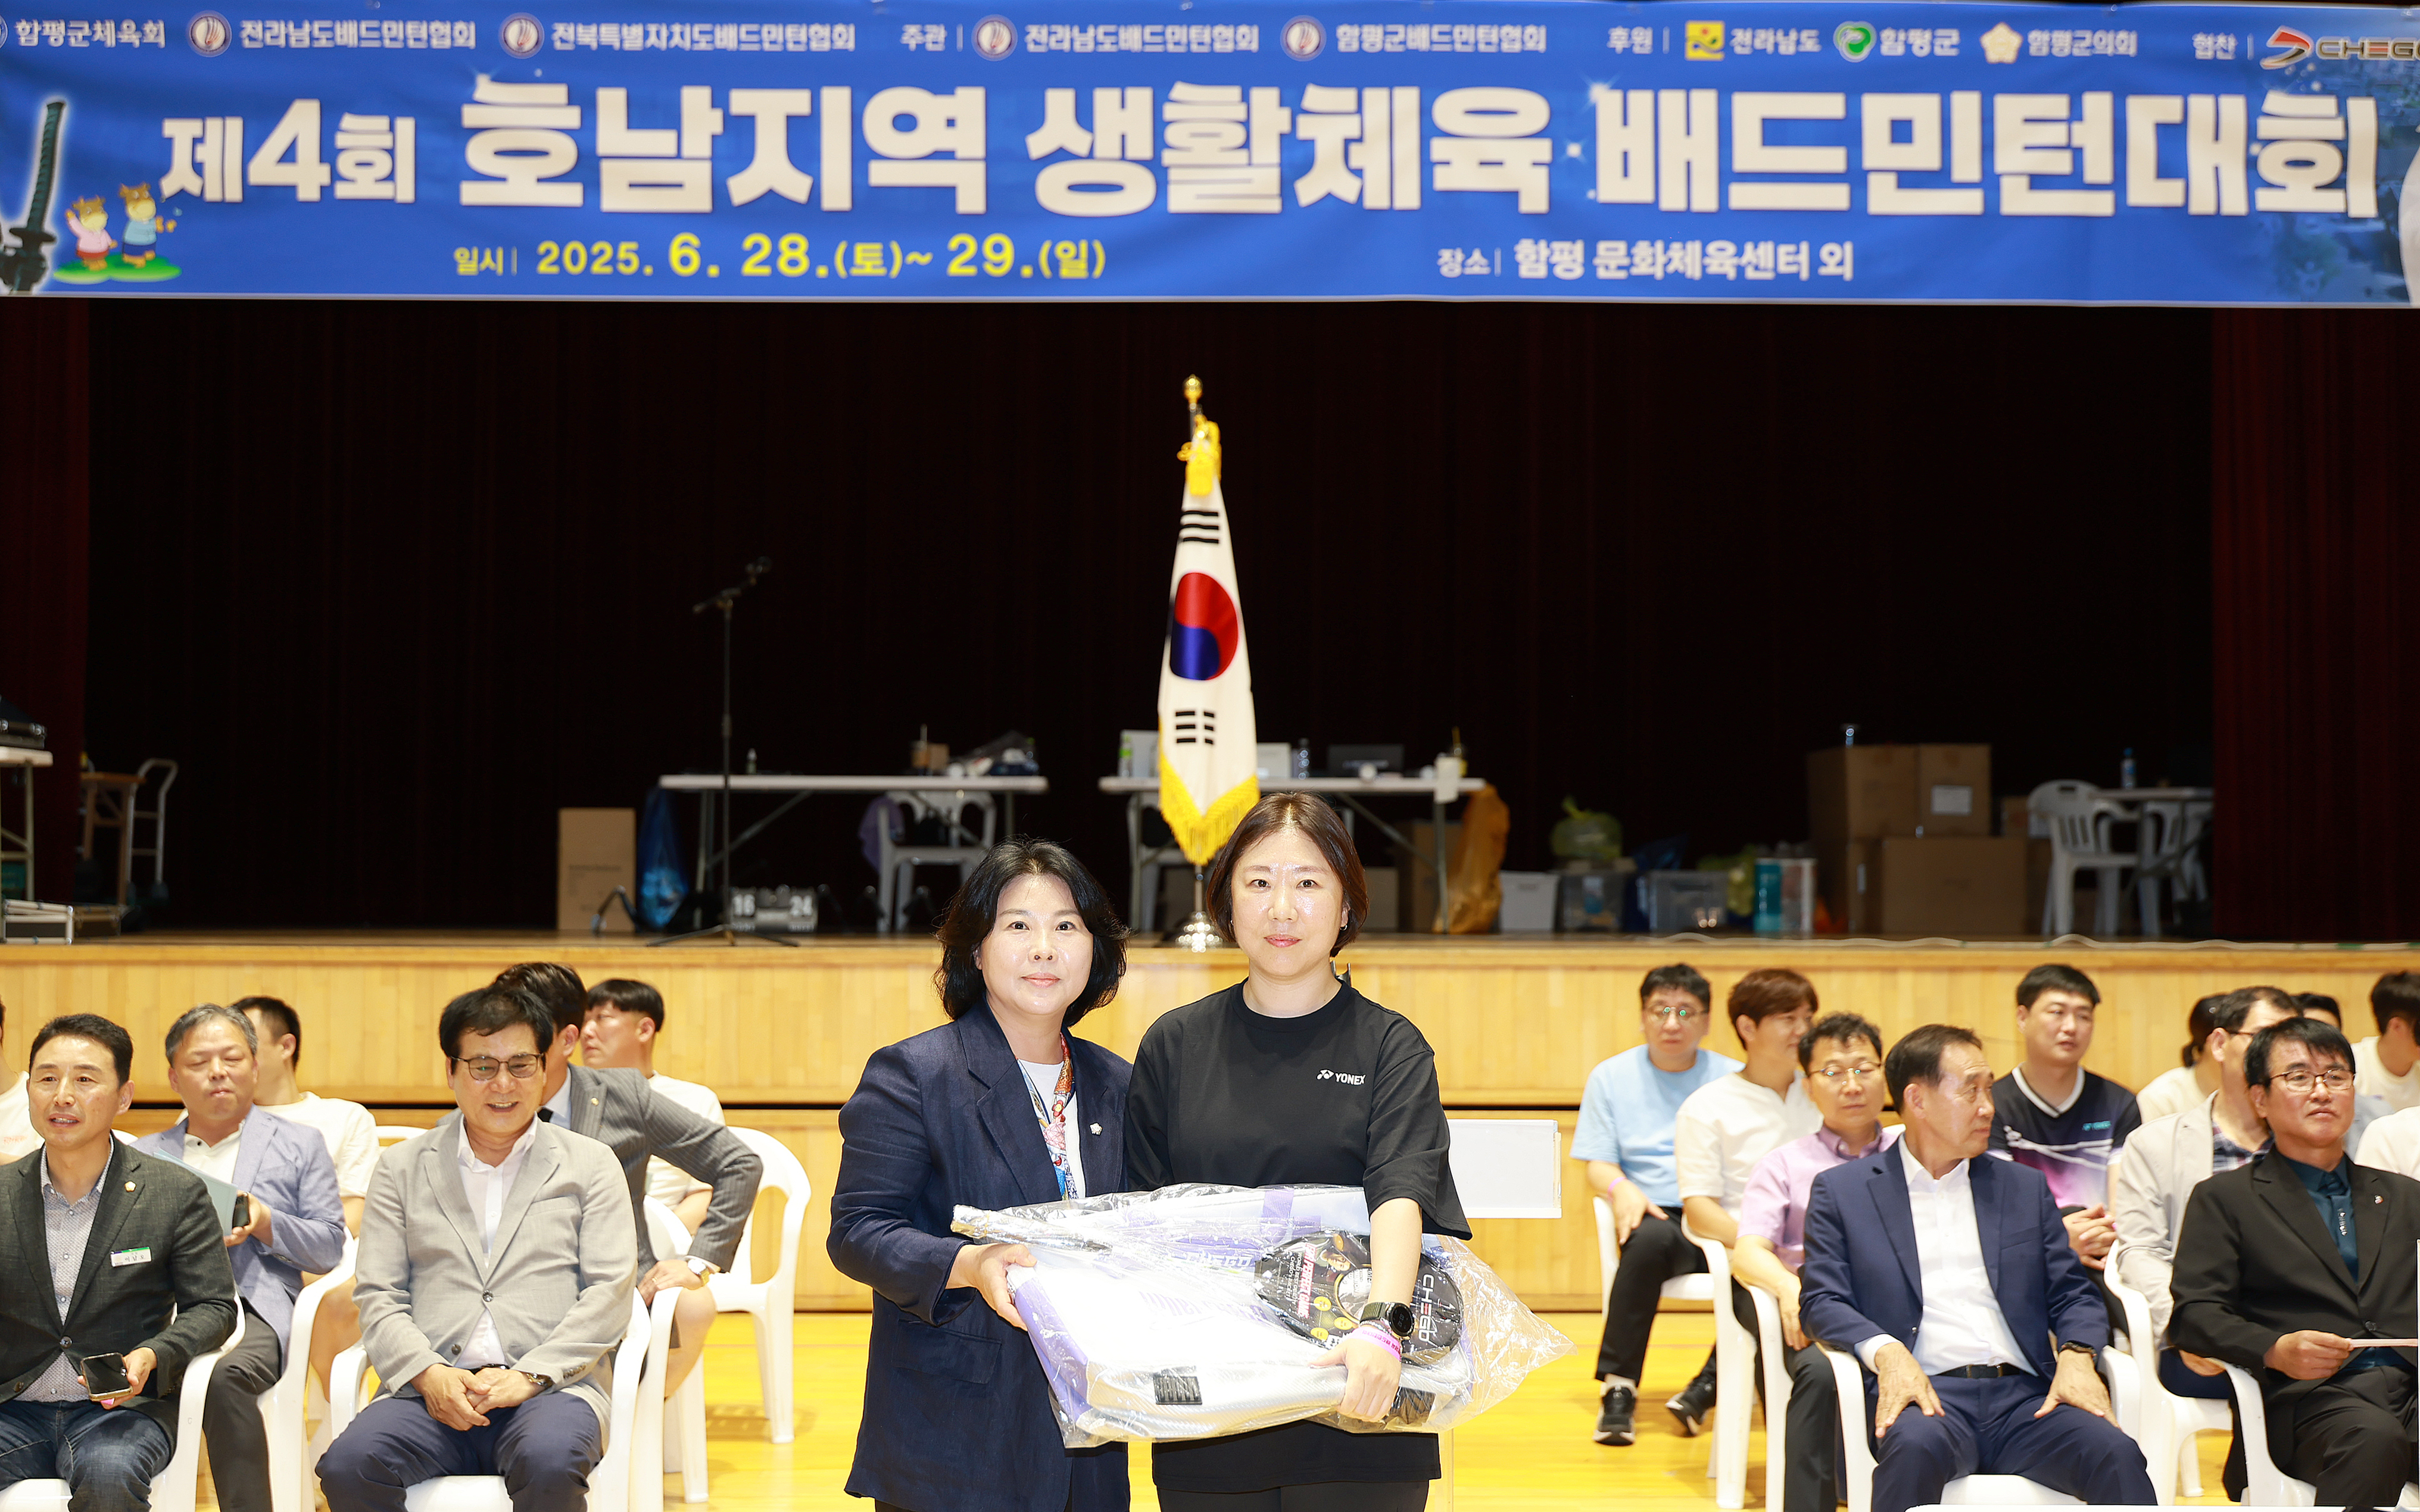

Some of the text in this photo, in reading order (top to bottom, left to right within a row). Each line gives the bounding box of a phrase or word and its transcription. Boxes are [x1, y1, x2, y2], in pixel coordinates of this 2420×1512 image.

[15, 20, 166, 48] 함평군체육회
[241, 20, 476, 49] 전라남도배드민턴협회
[552, 23, 856, 52] 전북특별자치도배드민턴협회
[901, 24, 947, 51] 주관
[1025, 24, 1259, 53] 전라남도배드민턴협회
[1336, 24, 1547, 53] 함평군배드민턴협회
[1608, 27, 1653, 54] 후원
[1731, 29, 1820, 55] 전라남도
[1880, 29, 1960, 57] 함평군
[2027, 30, 2138, 57] 함평군의회
[2193, 33, 2237, 60] 협찬
[2316, 36, 2420, 60] CHEG
[160, 74, 2378, 218] 제4회 호남지역 생활체육 배드민턴대회
[454, 248, 504, 276] 일시
[537, 240, 653, 276] 2025.
[669, 232, 720, 277] 6.
[947, 233, 1106, 279] 29.(일)
[1437, 238, 1854, 281] 장소 함평 문화체육센터 외
[1335, 1073, 1366, 1086] YONEX
[1300, 1261, 1315, 1294] PERFECT
